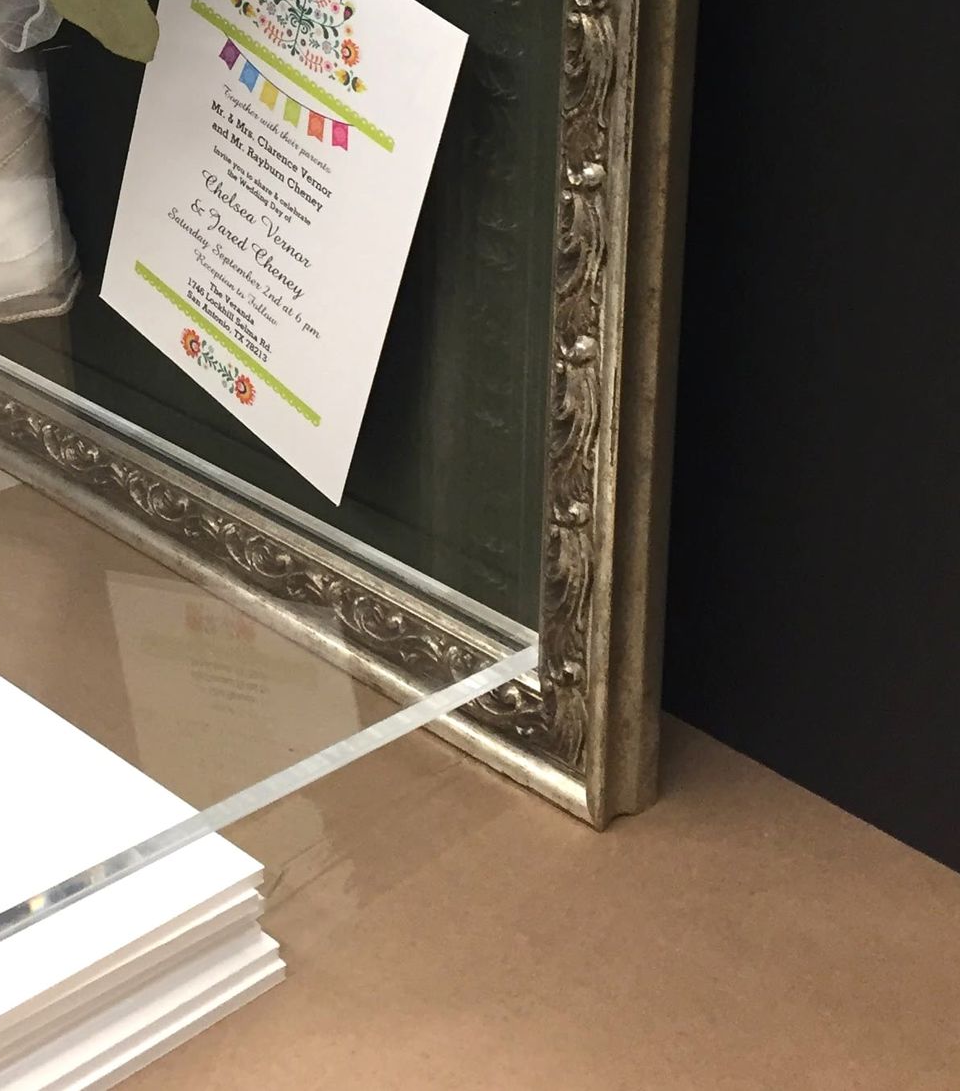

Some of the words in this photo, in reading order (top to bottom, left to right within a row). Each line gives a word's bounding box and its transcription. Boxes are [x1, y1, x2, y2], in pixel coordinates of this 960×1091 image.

[211, 100, 225, 118] Mr.
[227, 112, 234, 125] &
[236, 119, 254, 141] Mrs.
[257, 136, 298, 172] Clarence
[301, 167, 332, 198] Vernor
[212, 122, 229, 139] and
[230, 133, 244, 151] Mr.
[247, 146, 284, 182] Rayburn
[287, 178, 323, 212] Cheney
[224, 84, 259, 119] Together
[260, 118, 279, 134] with
[280, 131, 299, 150] their
[299, 148, 331, 173] parents
[202, 170, 256, 224] Chelsea
[261, 216, 311, 268] Vernor
[214, 145, 232, 164] Invite
[233, 162, 245, 175] you
[245, 171, 254, 181] to
[254, 179, 272, 195] share
[273, 191, 279, 201] &
[280, 199, 311, 226] celebrate
[226, 168, 238, 182] the
[240, 177, 269, 206] Wedding
[270, 201, 285, 218] Day
[285, 214, 293, 224] of
[168, 207, 209, 249] Saturday
[212, 244, 261, 290] September
[262, 286, 282, 306] 2nd
[281, 305, 294, 317] at
[294, 312, 302, 324] 6
[302, 323, 320, 338] pm
[191, 199, 205, 216] &
[207, 208, 248, 251] Jared
[252, 243, 304, 300] Cheney
[194, 249, 235, 291] Reception
[235, 287, 245, 299] to
[187, 290, 200, 307] San
[202, 303, 231, 333] Antonio,
[233, 328, 245, 344] TX
[246, 339, 267, 362] 78213
[205, 292, 234, 322] Lockhill
[235, 317, 257, 342] Selma
[210, 282, 223, 298] The
[226, 295, 254, 325] Veranda
